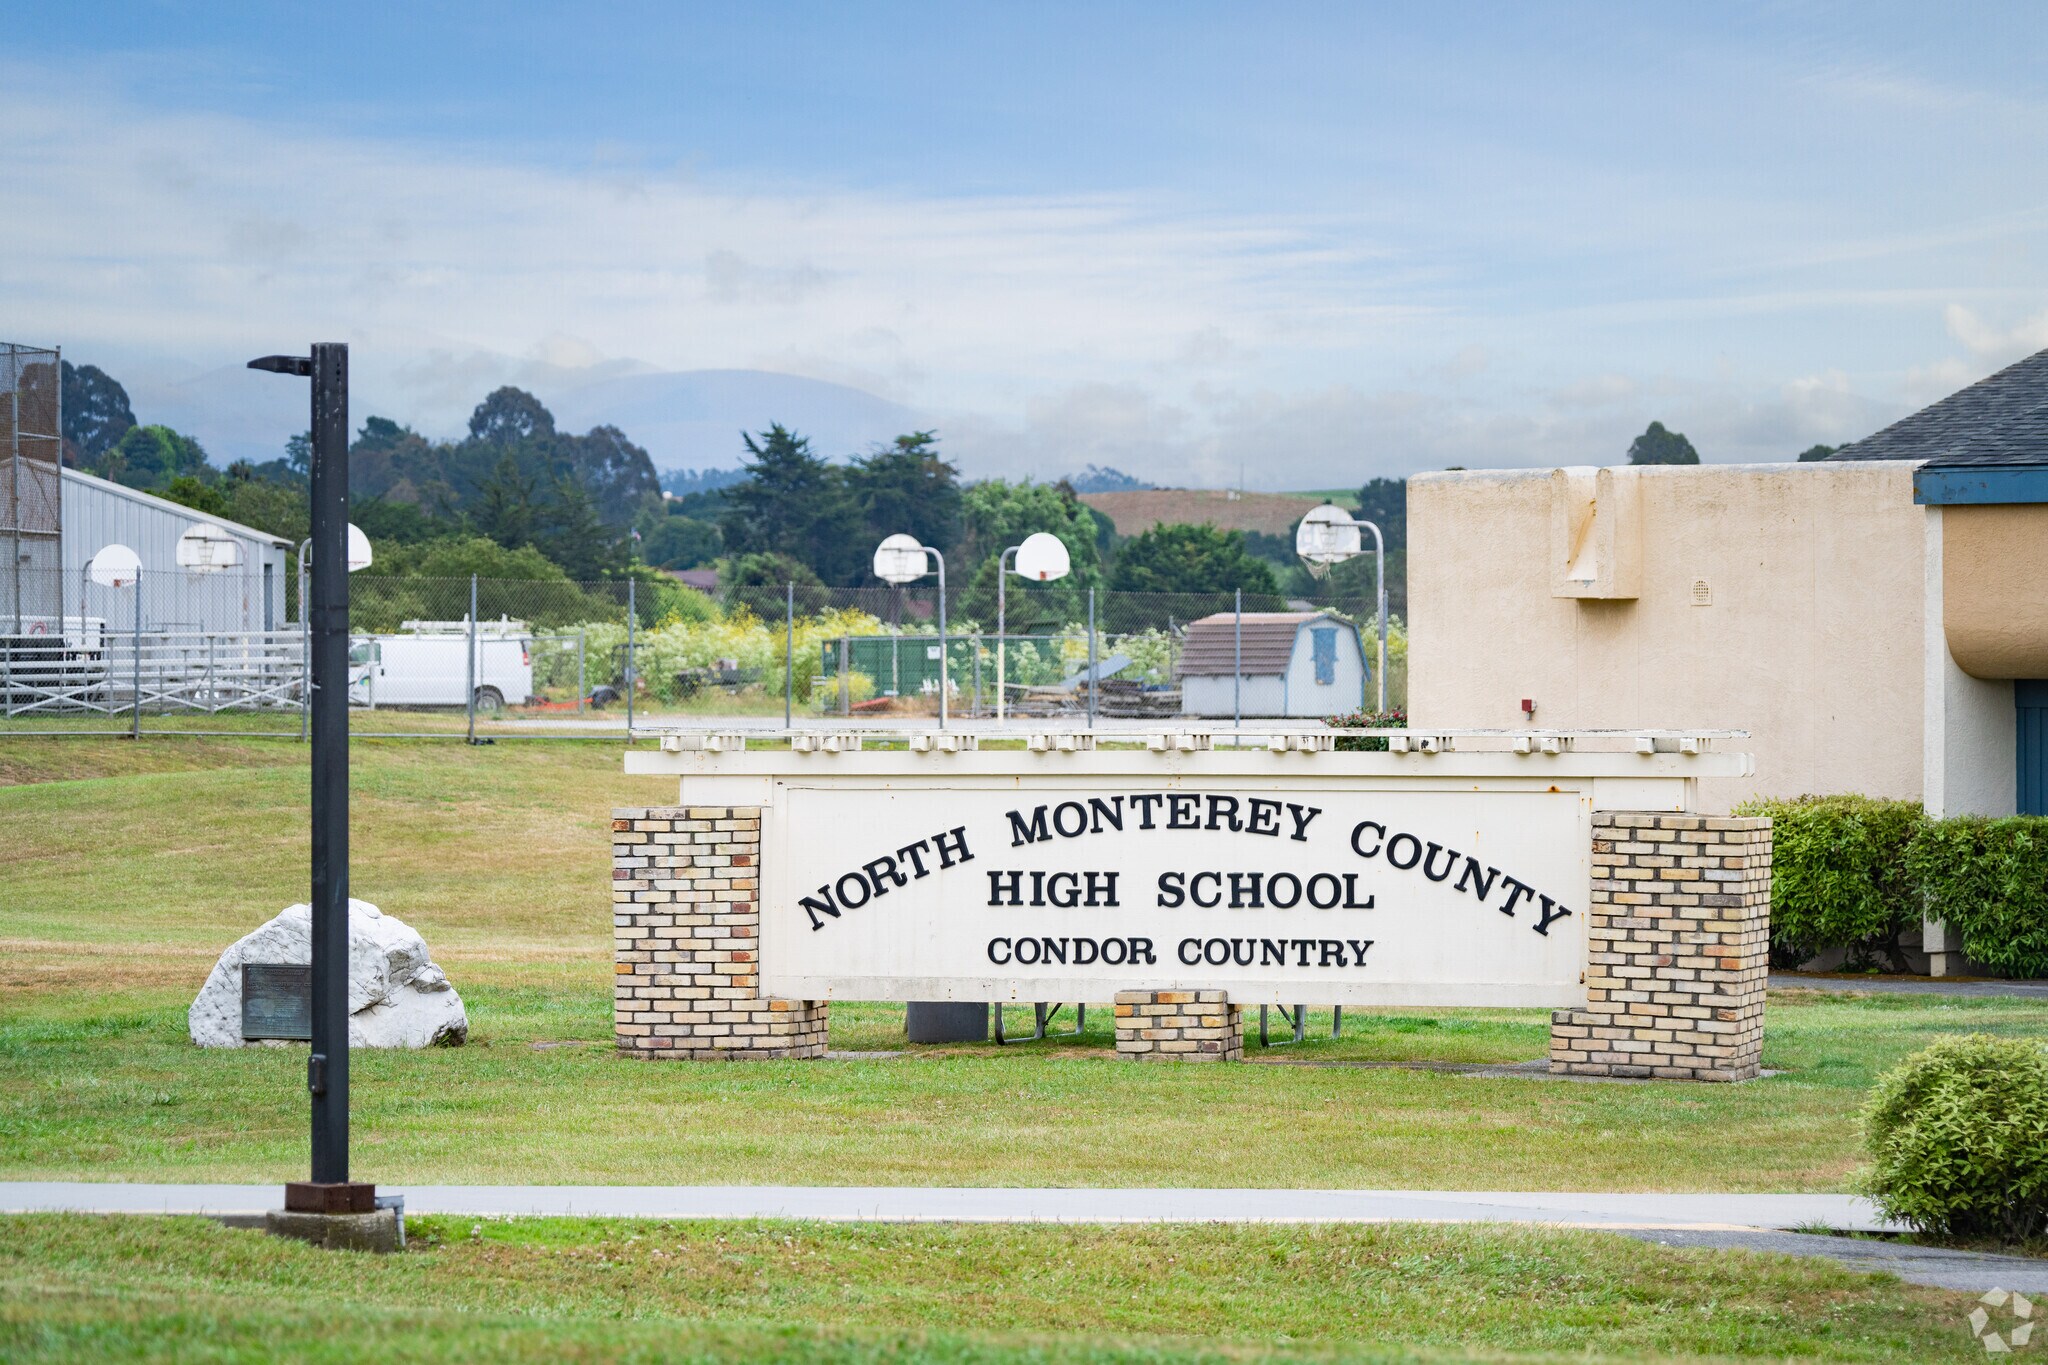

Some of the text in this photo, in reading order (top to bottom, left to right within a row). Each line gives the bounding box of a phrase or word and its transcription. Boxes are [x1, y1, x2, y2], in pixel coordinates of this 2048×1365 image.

[797, 793, 1573, 937] NORTH MONTEREY COUNTY
[986, 870, 1375, 910] HIGH SCHOOL
[987, 937, 1375, 968] CONDOR COUNTRY
